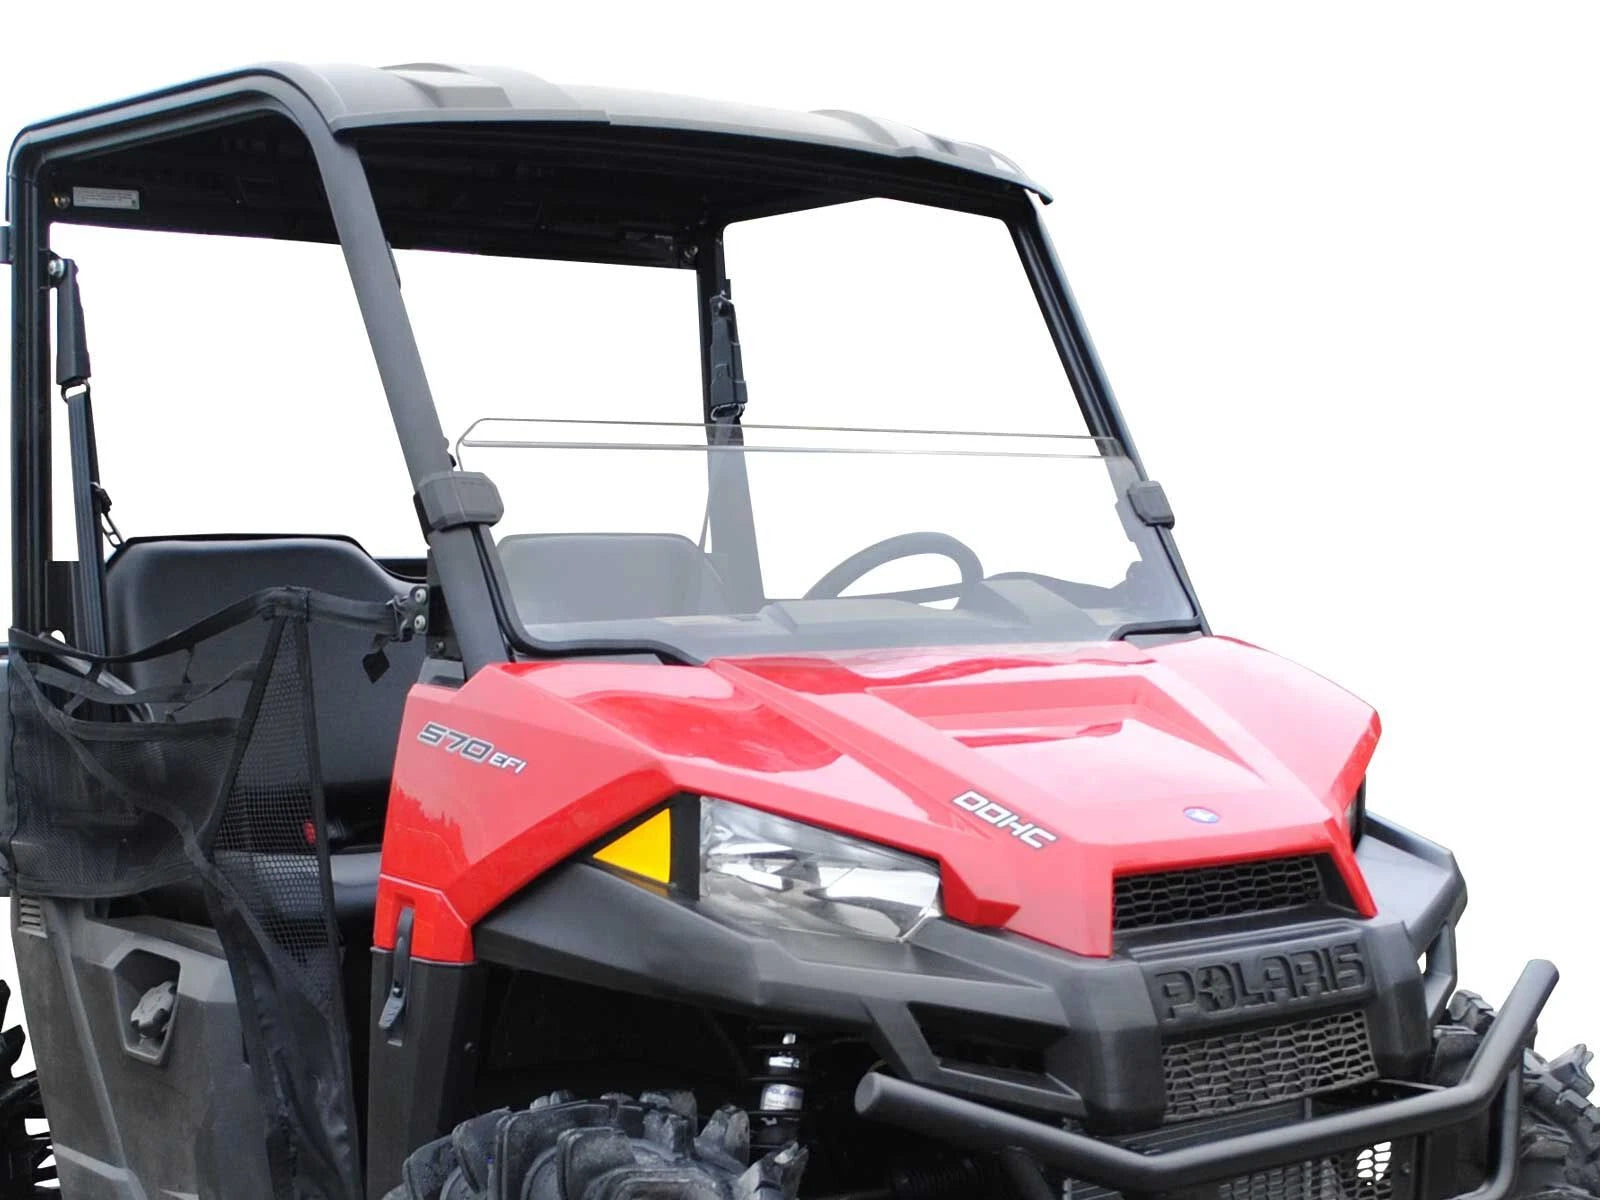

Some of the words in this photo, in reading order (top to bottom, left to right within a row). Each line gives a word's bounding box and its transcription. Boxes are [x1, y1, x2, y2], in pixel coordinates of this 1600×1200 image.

[418, 721, 494, 762] 570
[489, 752, 526, 773] EFI
[952, 789, 1057, 849] DOHC
[1154, 942, 1366, 1021] POLARIS
